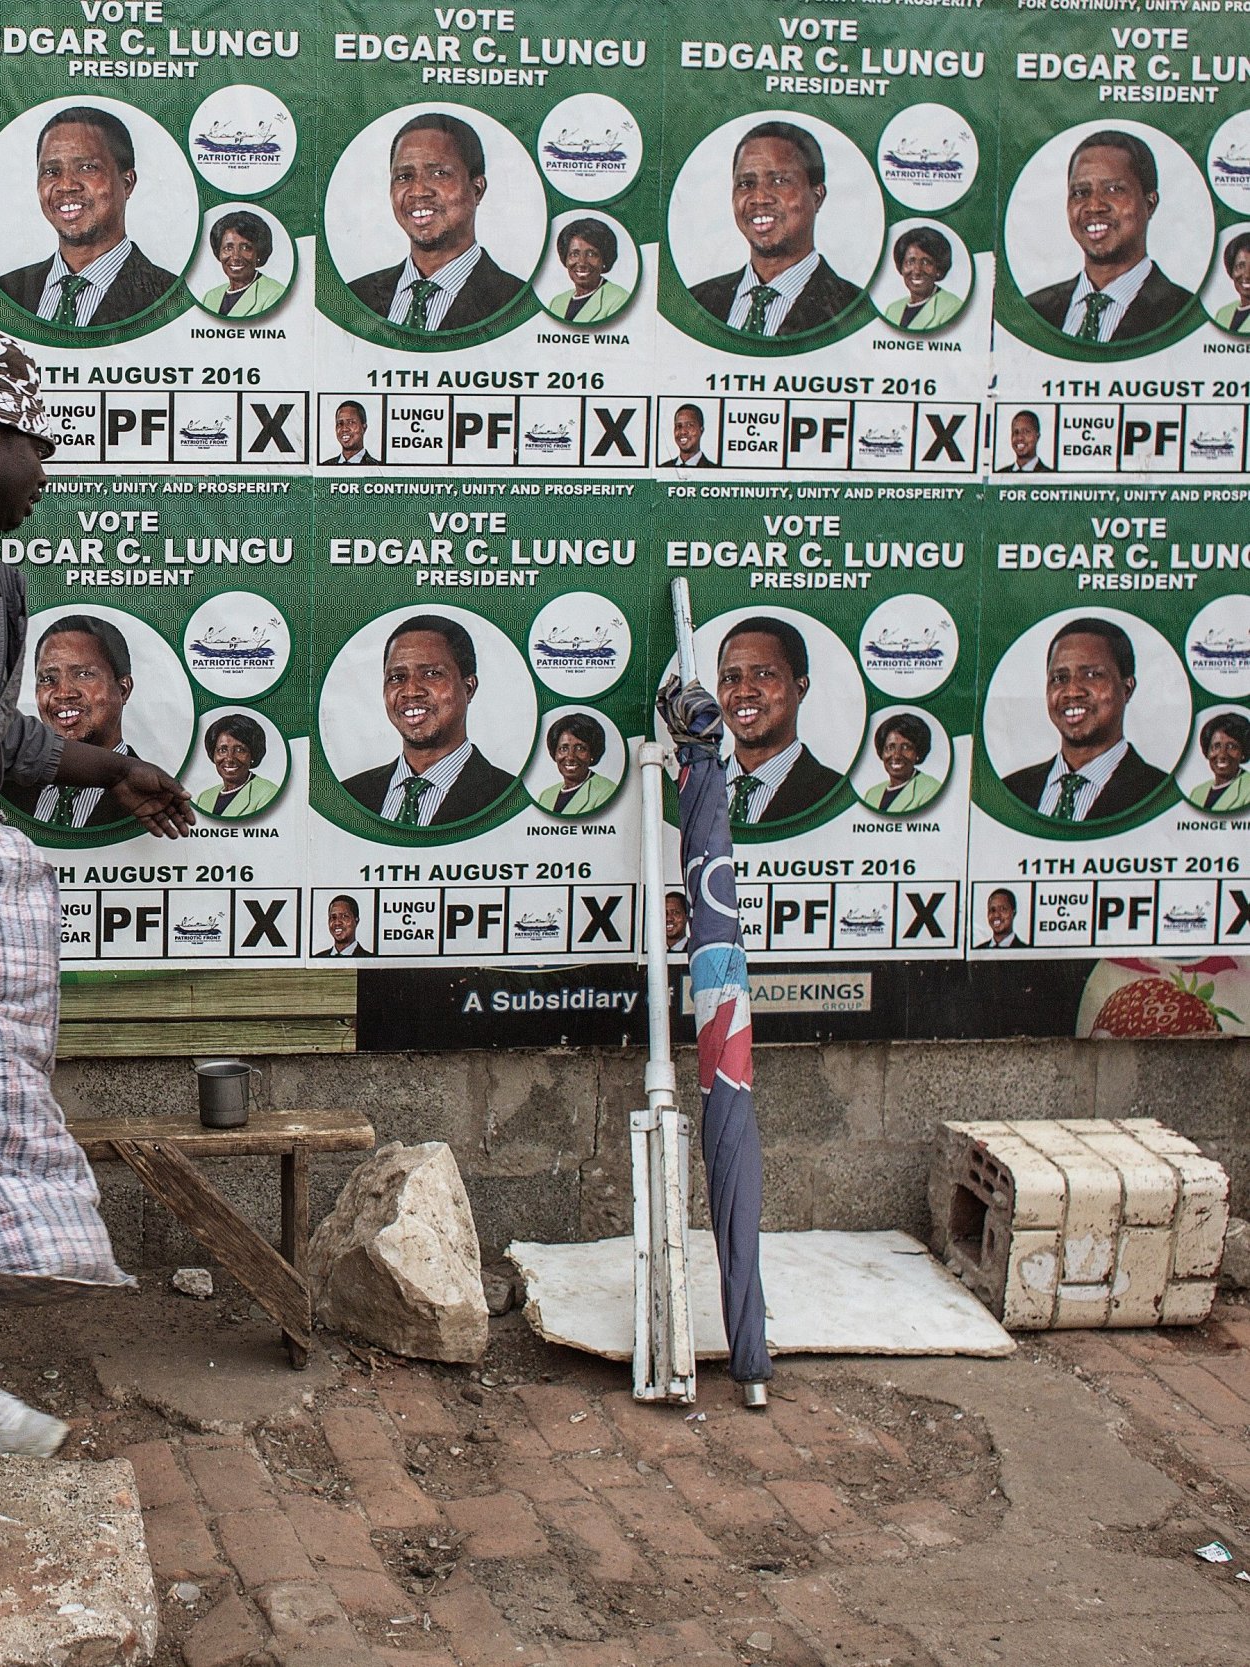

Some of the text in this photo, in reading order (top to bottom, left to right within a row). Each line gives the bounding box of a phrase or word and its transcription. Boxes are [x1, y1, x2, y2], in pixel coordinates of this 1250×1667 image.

[82, 0, 162, 22] VOTE
[435, 8, 513, 30] VOTE
[779, 17, 856, 40] VOTE
[1113, 27, 1187, 48] VOTE
[121, 30, 154, 54] C.
[170, 30, 298, 56] LUNGU
[336, 33, 644, 65] EDGAR C. LUNGU
[70, 60, 199, 77] PRESIDENT
[682, 42, 984, 76] EDGAR C. LUNGU
[1018, 53, 1178, 80] EDGAR C.
[424, 67, 548, 84] PRESIDENT
[767, 76, 889, 94] PRESIDENT
[1100, 85, 1219, 102] PRESIDENT
[873, 340, 962, 351] INONGE WINA
[368, 370, 604, 390] 11TH AUGUST 2016
[706, 374, 936, 396] 11TH AUGUST 2016
[392, 409, 444, 420] LUNGU
[109, 409, 167, 445] PF
[411, 421, 424, 432] C.
[591, 409, 637, 456] X
[791, 417, 847, 452] PF
[392, 437, 443, 448] EDGAR
[668, 487, 964, 501] FOR CONTINUITY, UNITY AND PROSPERITY
[78, 511, 158, 532] VOTE
[429, 512, 506, 532] VOTE
[764, 515, 839, 535] VOTE
[1091, 518, 1165, 538] VOTE
[117, 538, 292, 563] C. LUNGU
[331, 538, 634, 564] EDGAR C. LUNGU
[668, 541, 963, 567] EDGAR C. LUNGU
[998, 544, 1156, 568] EDGAR C.
[67, 568, 194, 585] PRESIDENT
[416, 568, 540, 586] PRESIDENT
[751, 571, 871, 588] PRESIDENT
[1079, 572, 1197, 589] PRESIDENT
[527, 826, 616, 835] INONGE WINA
[361, 862, 590, 882] 11TH AUGUST 2016
[1039, 894, 1088, 905] LUNGU
[578, 896, 623, 943] X
[774, 899, 829, 933] PF
[1057, 906, 1069, 916] C.
[103, 906, 161, 942] PF
[1039, 920, 1087, 930] EDGAR
[464, 989, 638, 1013] A Subsidiary
[822, 1002, 862, 1011] GROUP
